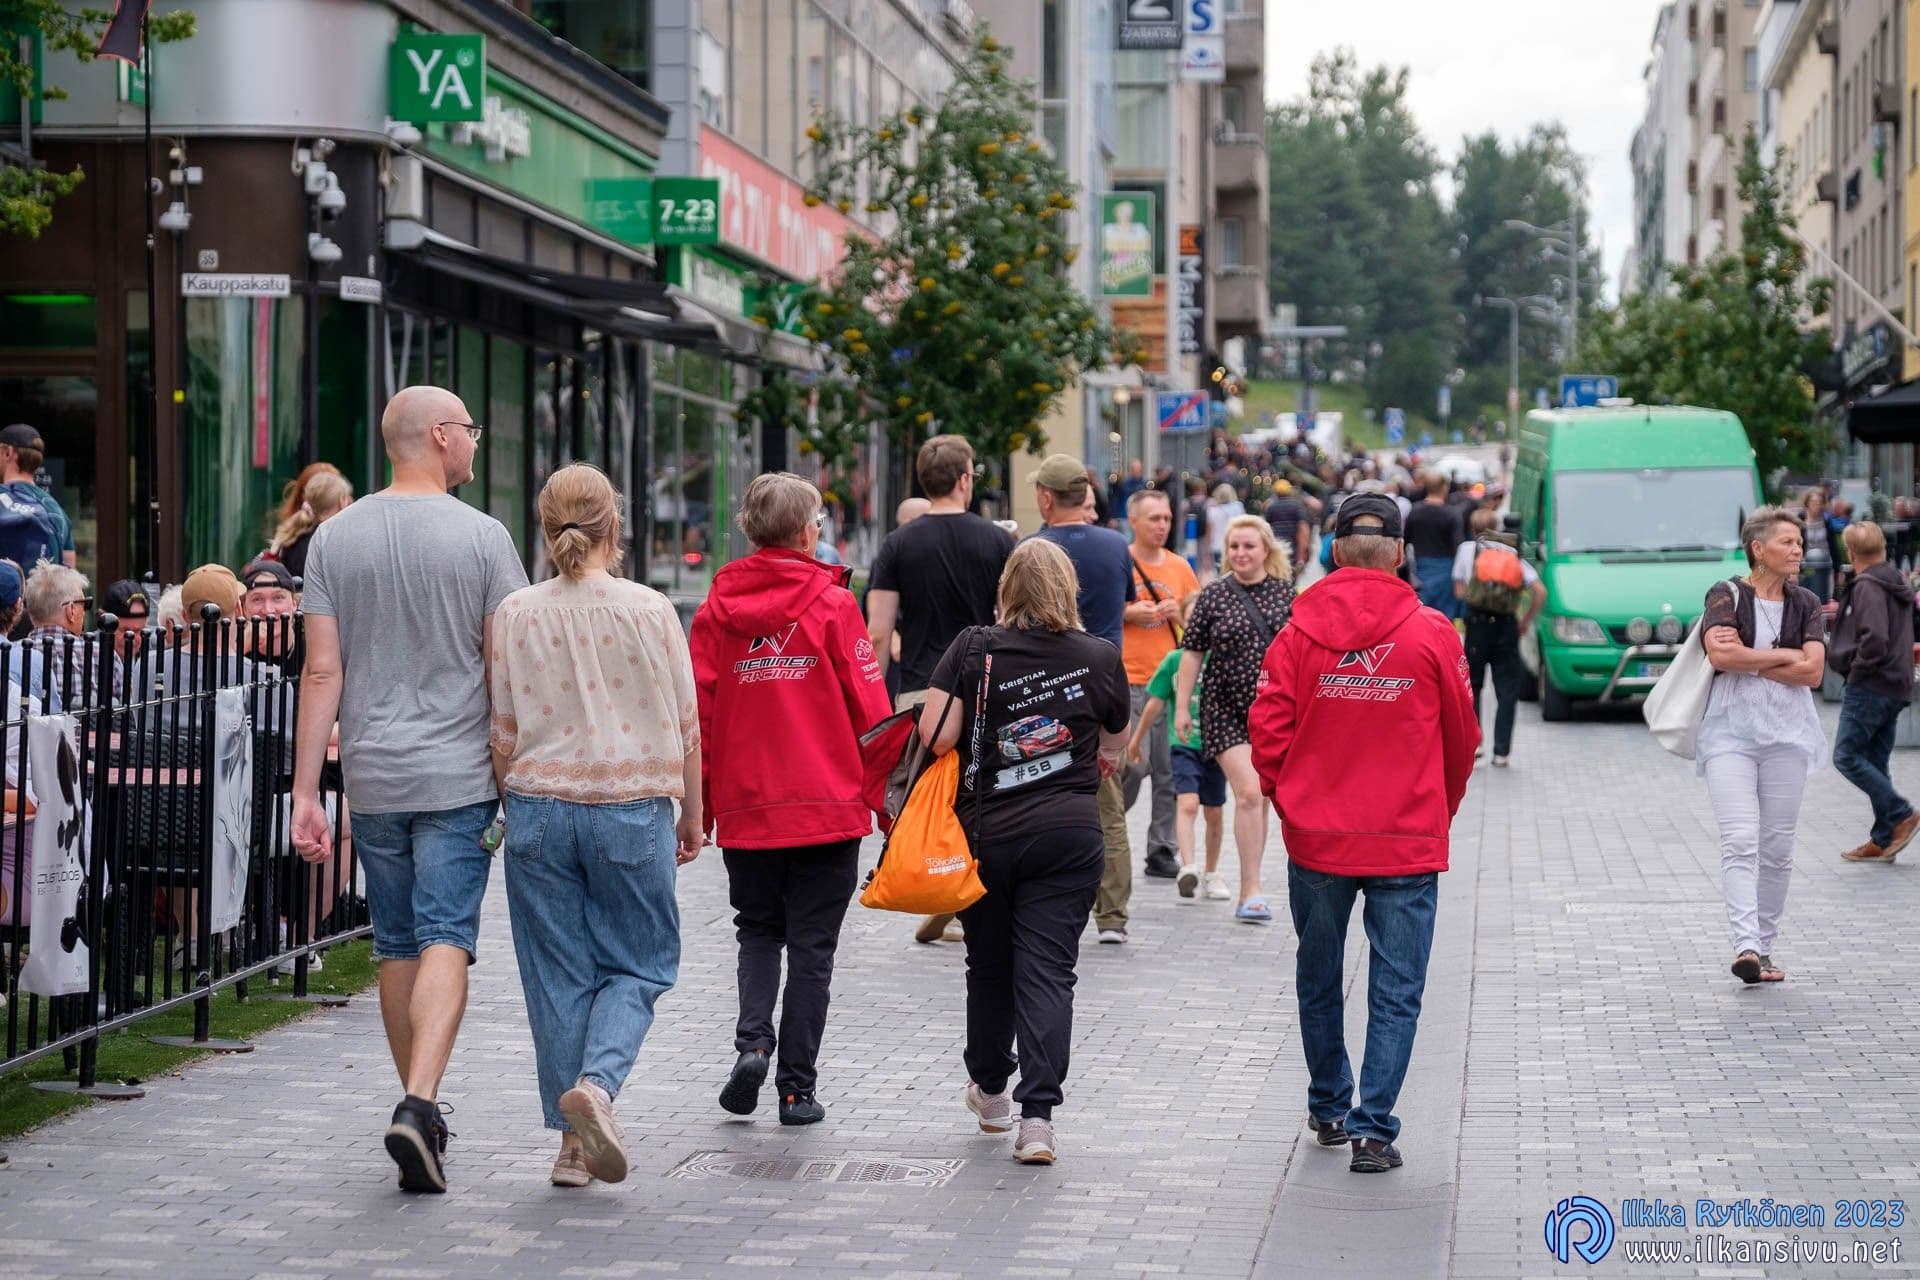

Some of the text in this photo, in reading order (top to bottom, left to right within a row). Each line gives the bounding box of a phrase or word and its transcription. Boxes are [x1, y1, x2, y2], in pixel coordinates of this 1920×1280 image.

[407, 49, 473, 110] YA
[659, 199, 716, 223] 7-23
[186, 274, 286, 293] Kauppakatu
[734, 655, 818, 673] NIEMINEN
[738, 668, 809, 684] RACING
[1041, 667, 1090, 689] NIEMINEN
[1007, 690, 1055, 712] VALTTERI
[1316, 686, 1401, 702] RACING
